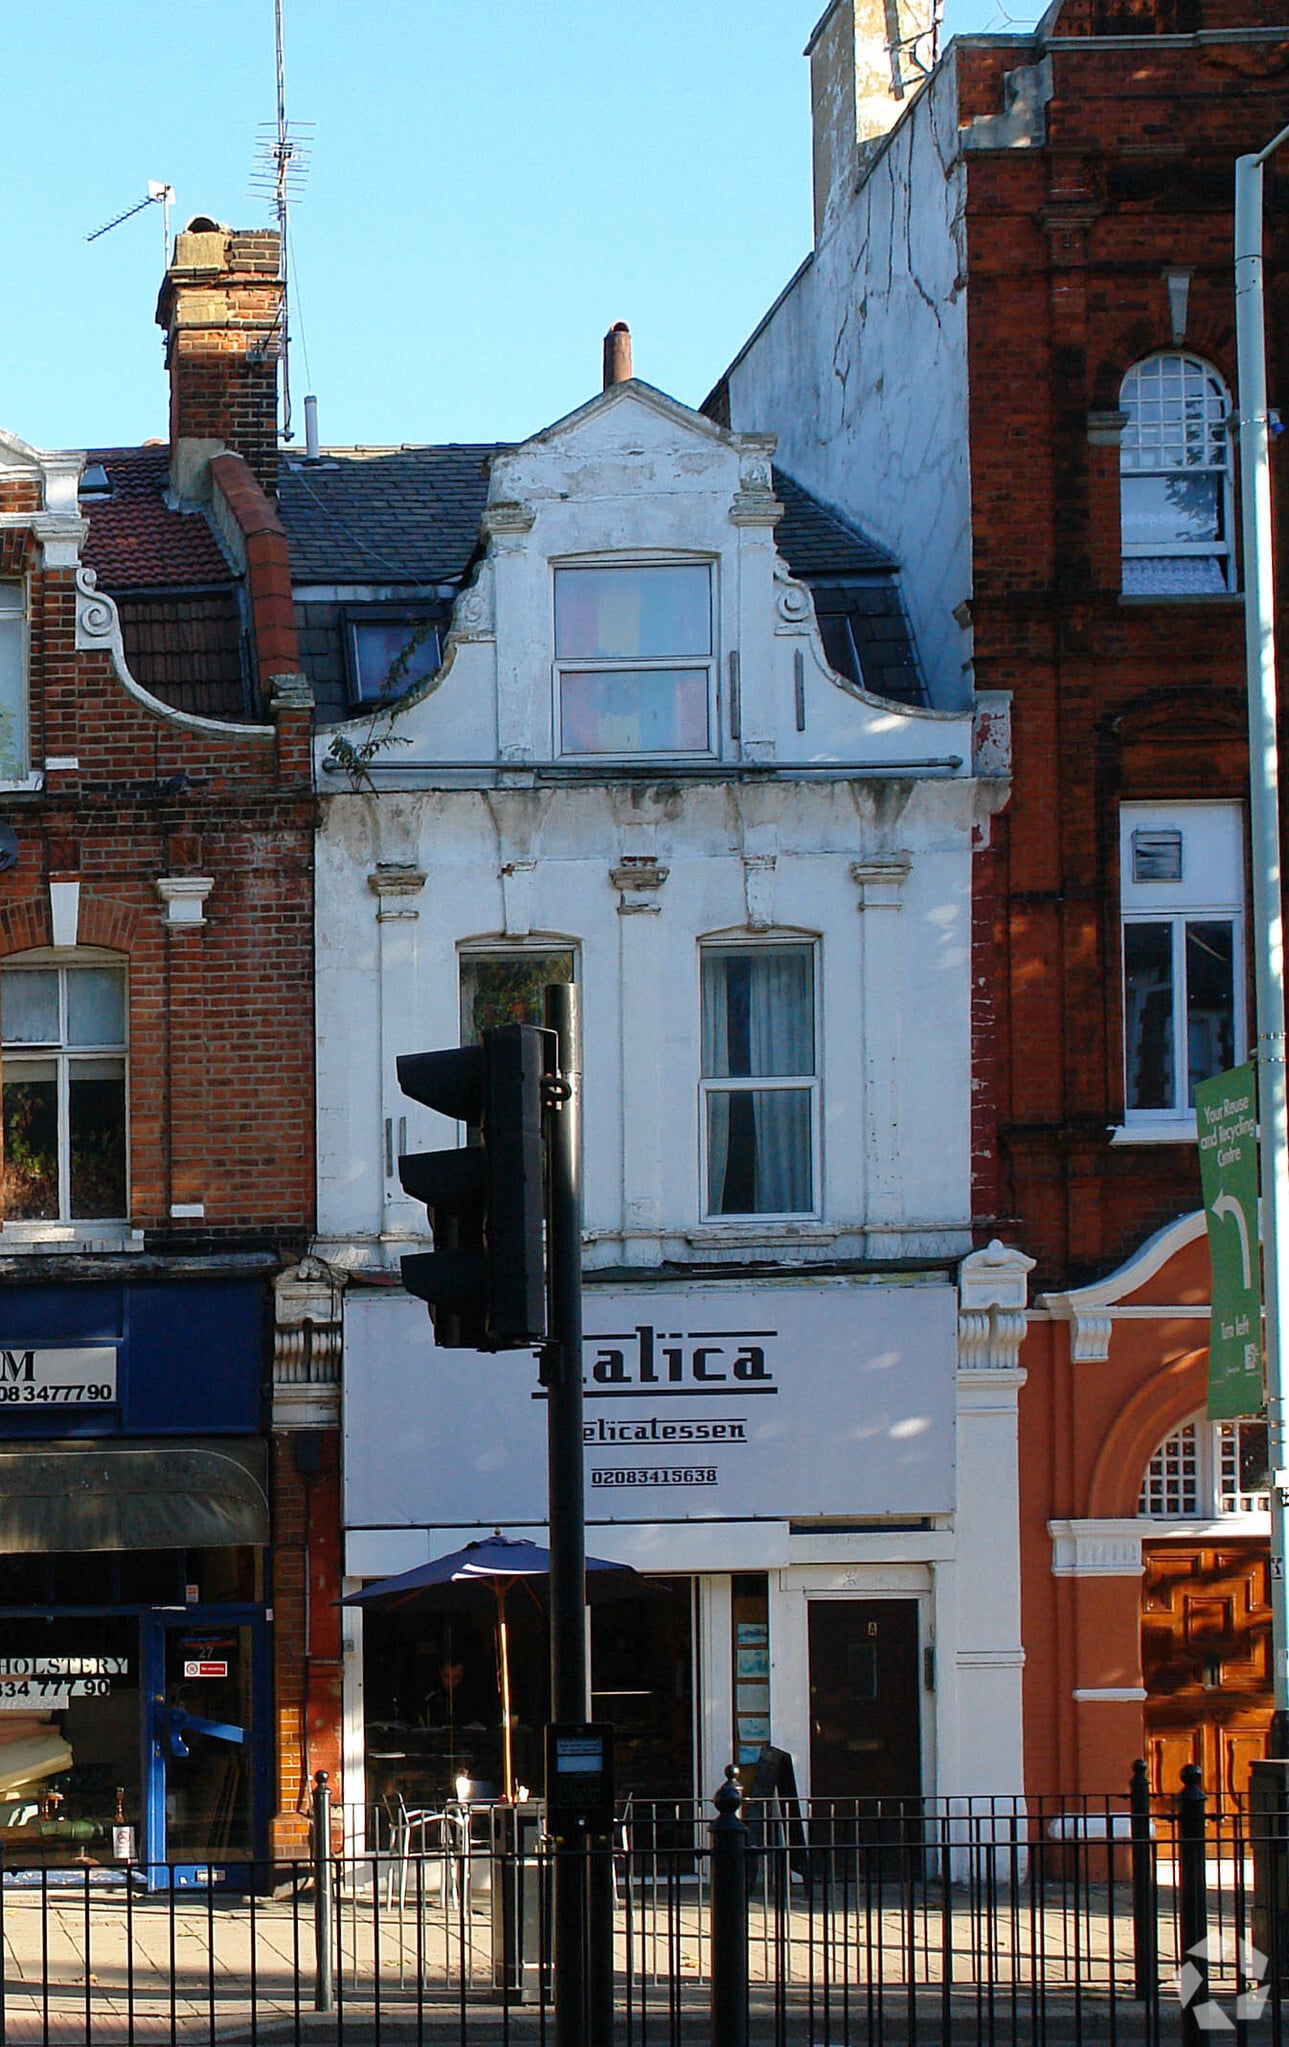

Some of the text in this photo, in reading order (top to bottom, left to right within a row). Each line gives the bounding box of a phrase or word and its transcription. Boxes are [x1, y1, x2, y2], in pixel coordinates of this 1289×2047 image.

[1204, 1106, 1223, 1125] Your
[1201, 1125, 1217, 1149] and
[583, 1418, 746, 1441] elicatessen
[591, 1469, 717, 1485] 02083415638
[199, 1646, 214, 1660] 27
[84, 1680, 109, 1696] 90
